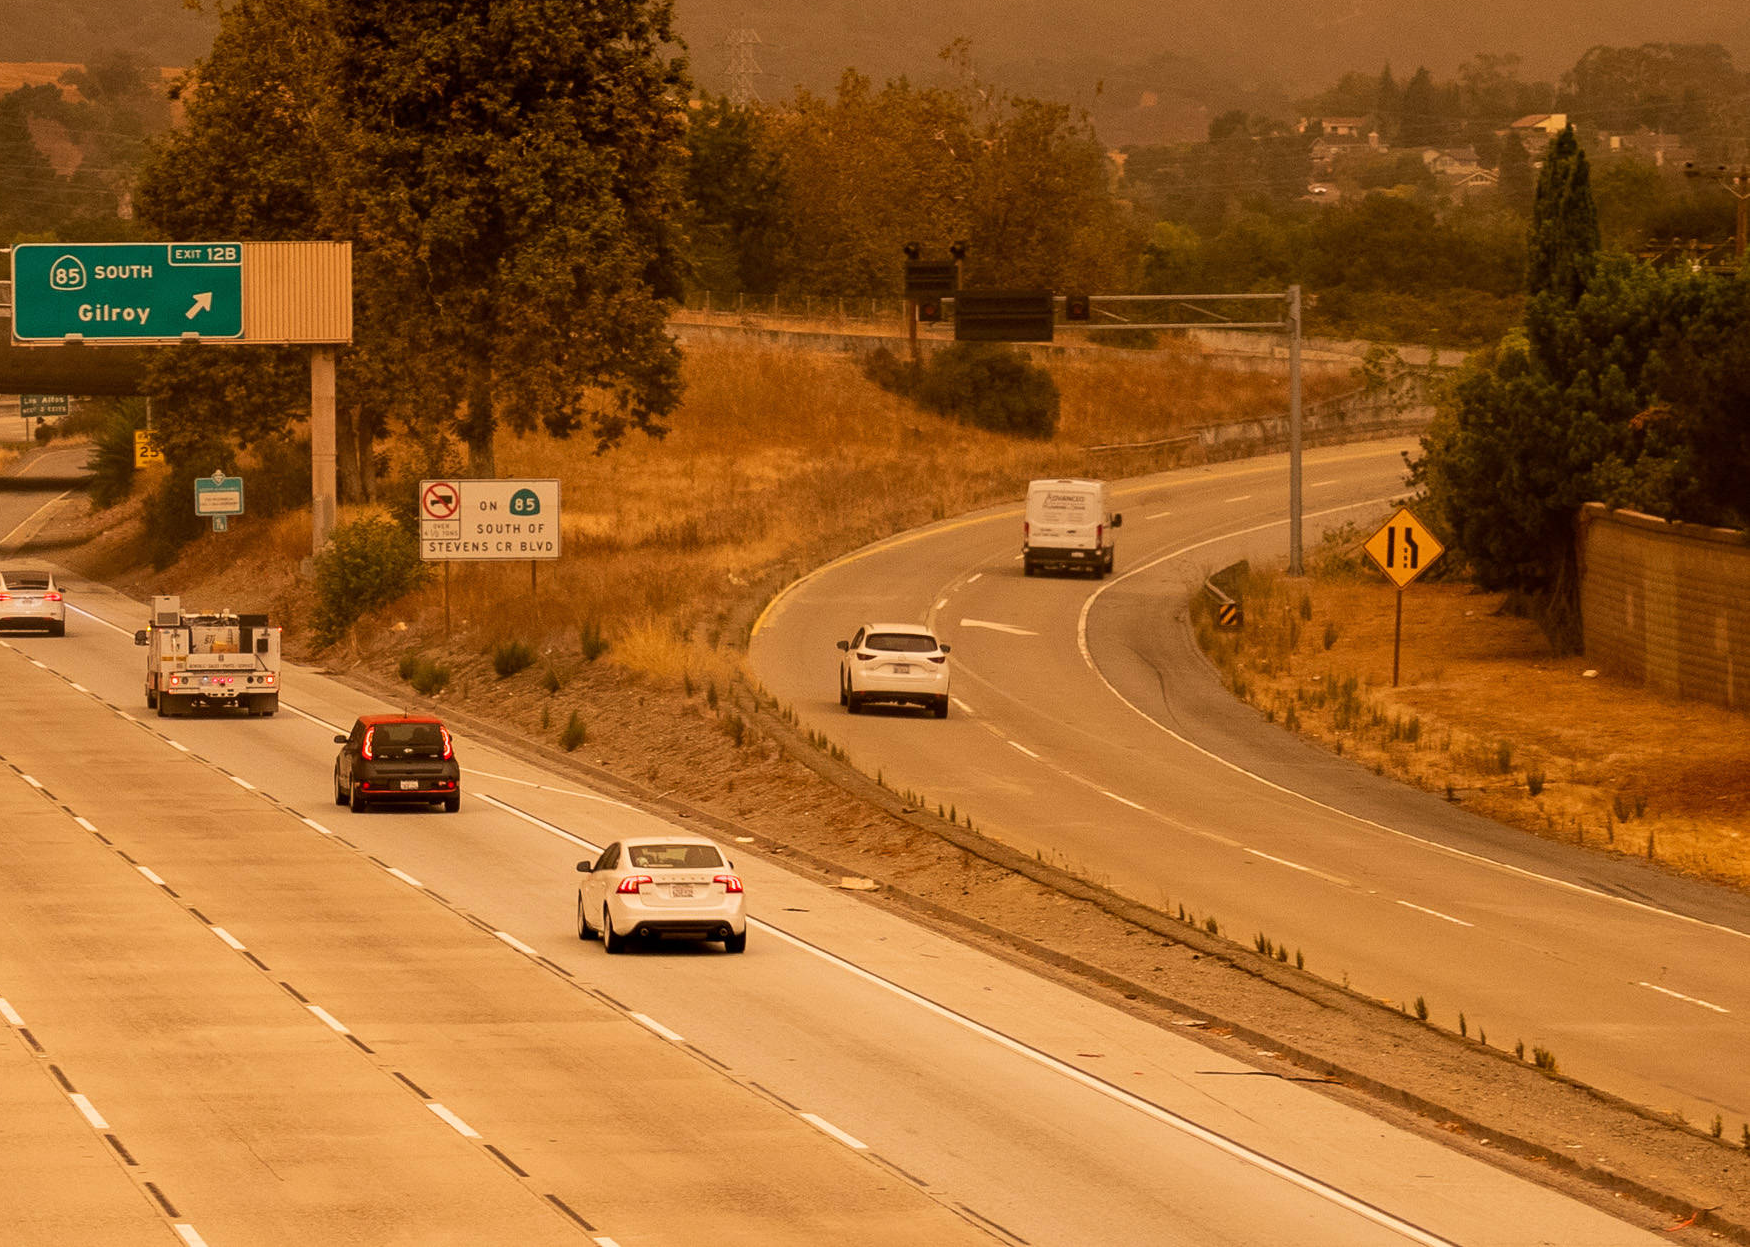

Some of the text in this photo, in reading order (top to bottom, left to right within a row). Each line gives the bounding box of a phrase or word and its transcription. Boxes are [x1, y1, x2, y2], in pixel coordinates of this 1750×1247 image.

[175, 247, 237, 261] EXIT 12B
[55, 265, 153, 284] 85 SOUTH
[78, 304, 151, 325] Gilroy
[41, 396, 64, 404] Altos
[140, 446, 160, 457] 25
[479, 498, 535, 511] ON 85
[477, 524, 545, 534] SOUTH OF
[429, 542, 553, 552] STEVENS CR BLVD
